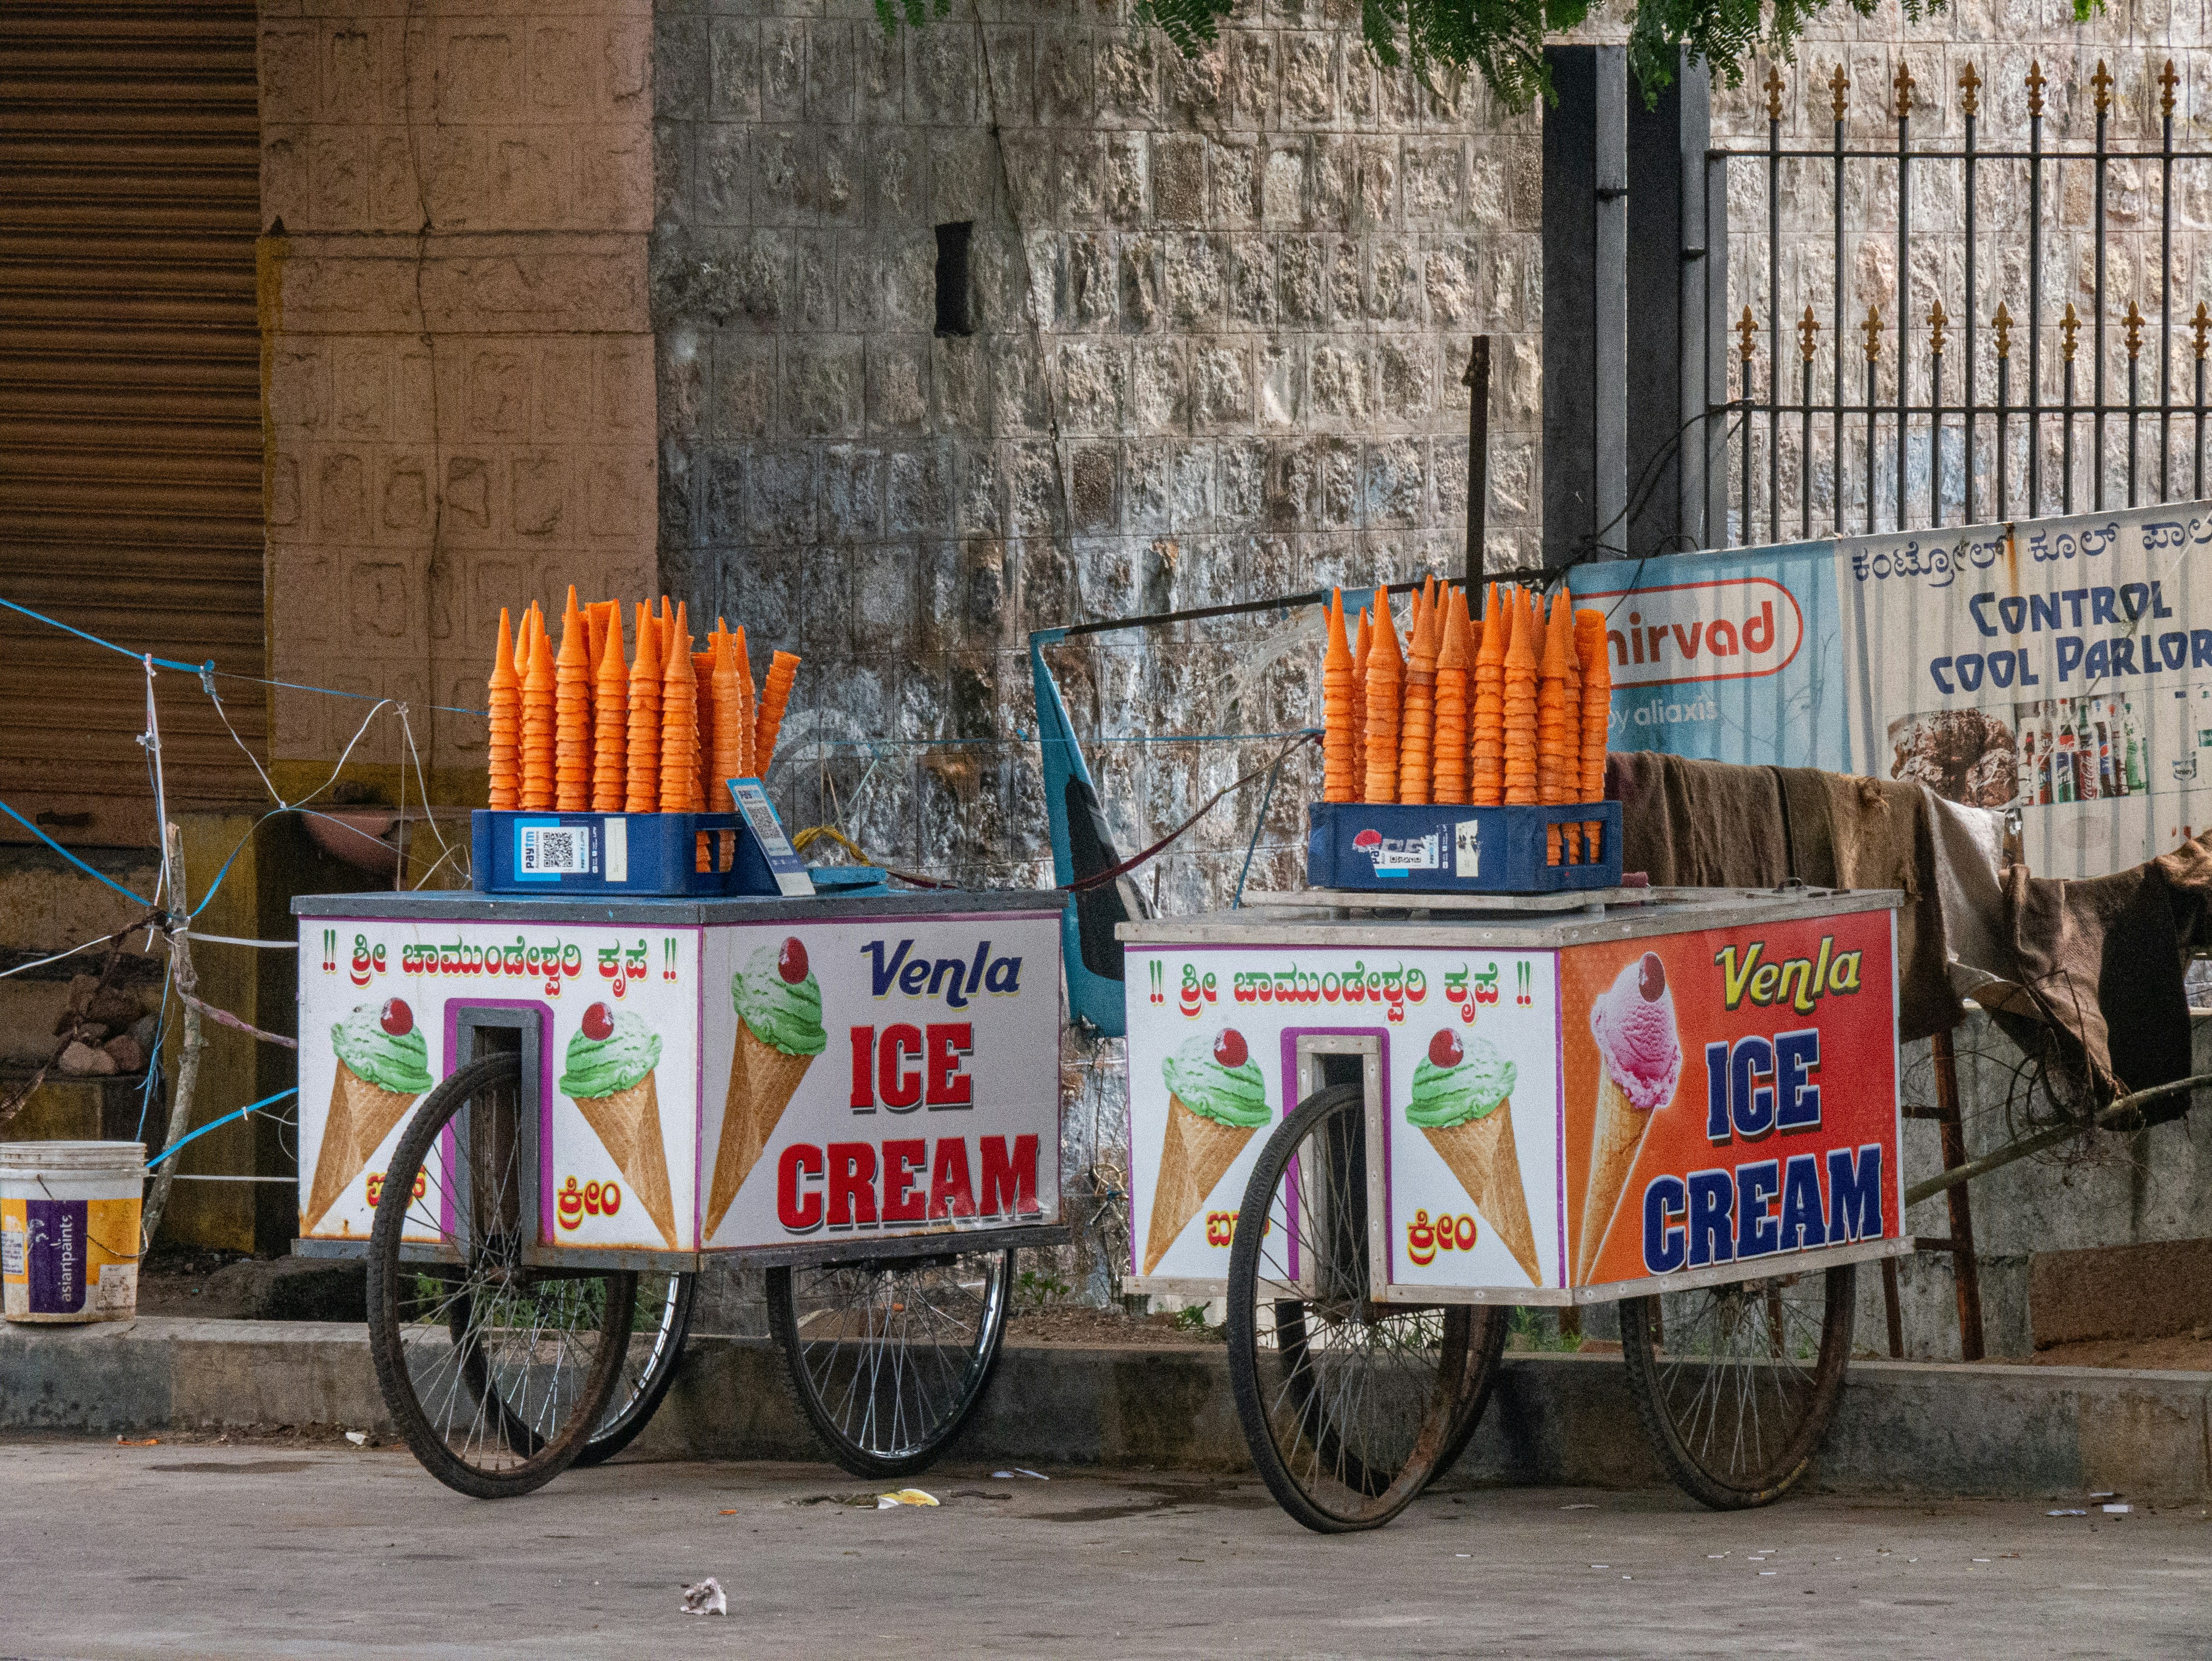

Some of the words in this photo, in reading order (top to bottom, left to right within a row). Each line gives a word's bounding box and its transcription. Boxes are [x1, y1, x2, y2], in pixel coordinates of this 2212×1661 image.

[2029, 522, 2120, 563] ಕೂಲ್
[1969, 580, 2172, 637] CONTROL
[1930, 648, 2039, 694] COOL
[2055, 629, 2212, 682] PARLOR
[1637, 696, 1717, 725] aliaxis
[850, 1022, 974, 1114] ICE
[1705, 1028, 1821, 1147] ICE
[777, 1133, 1043, 1234] CREAM
[1643, 1143, 1883, 1276] CREAM
[59, 1214, 78, 1302] asianpaints
[1206, 1210, 1271, 1248] ಐ
